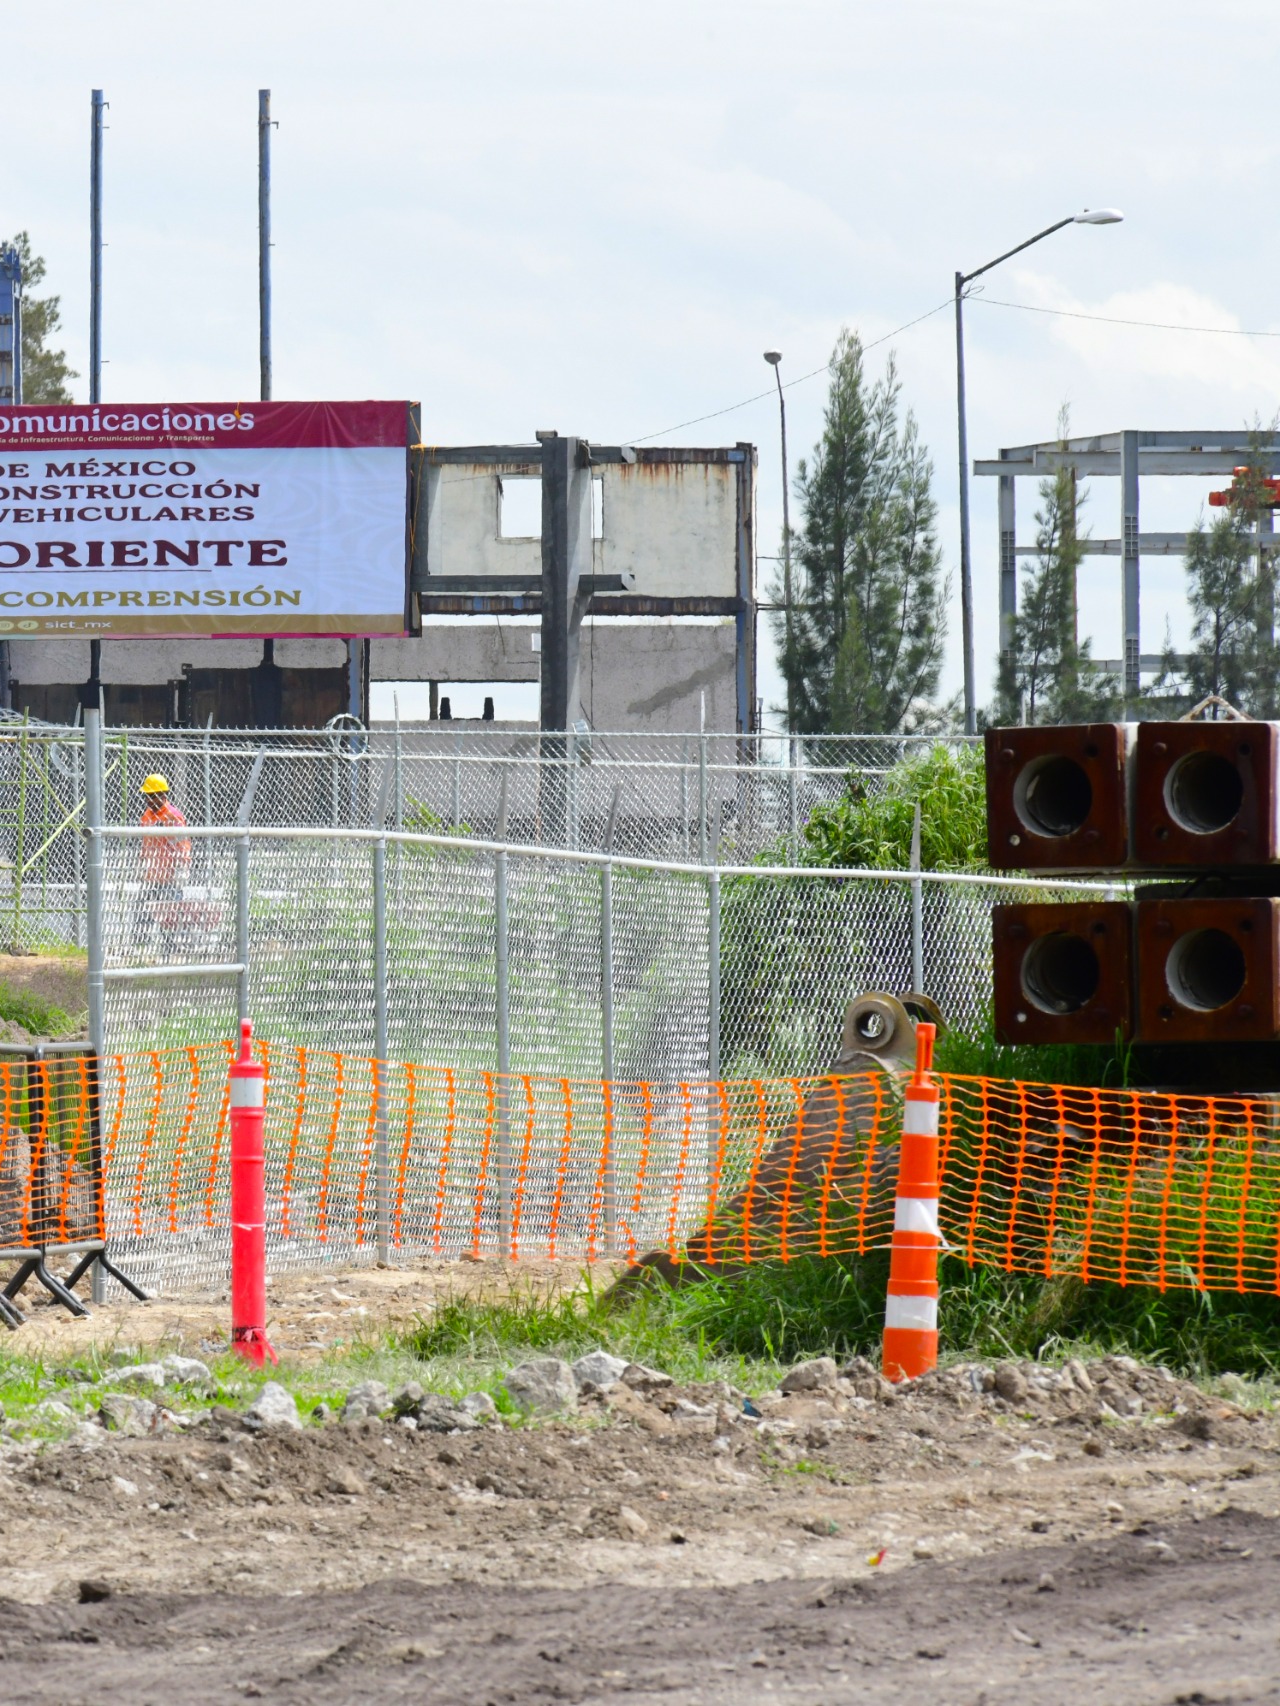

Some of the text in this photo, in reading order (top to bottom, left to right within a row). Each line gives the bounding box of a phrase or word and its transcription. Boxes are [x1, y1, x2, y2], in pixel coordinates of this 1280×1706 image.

[165, 434, 215, 442] Transportes
[45, 458, 196, 478] MÉXICO
[45, 620, 112, 630] sict_mx
